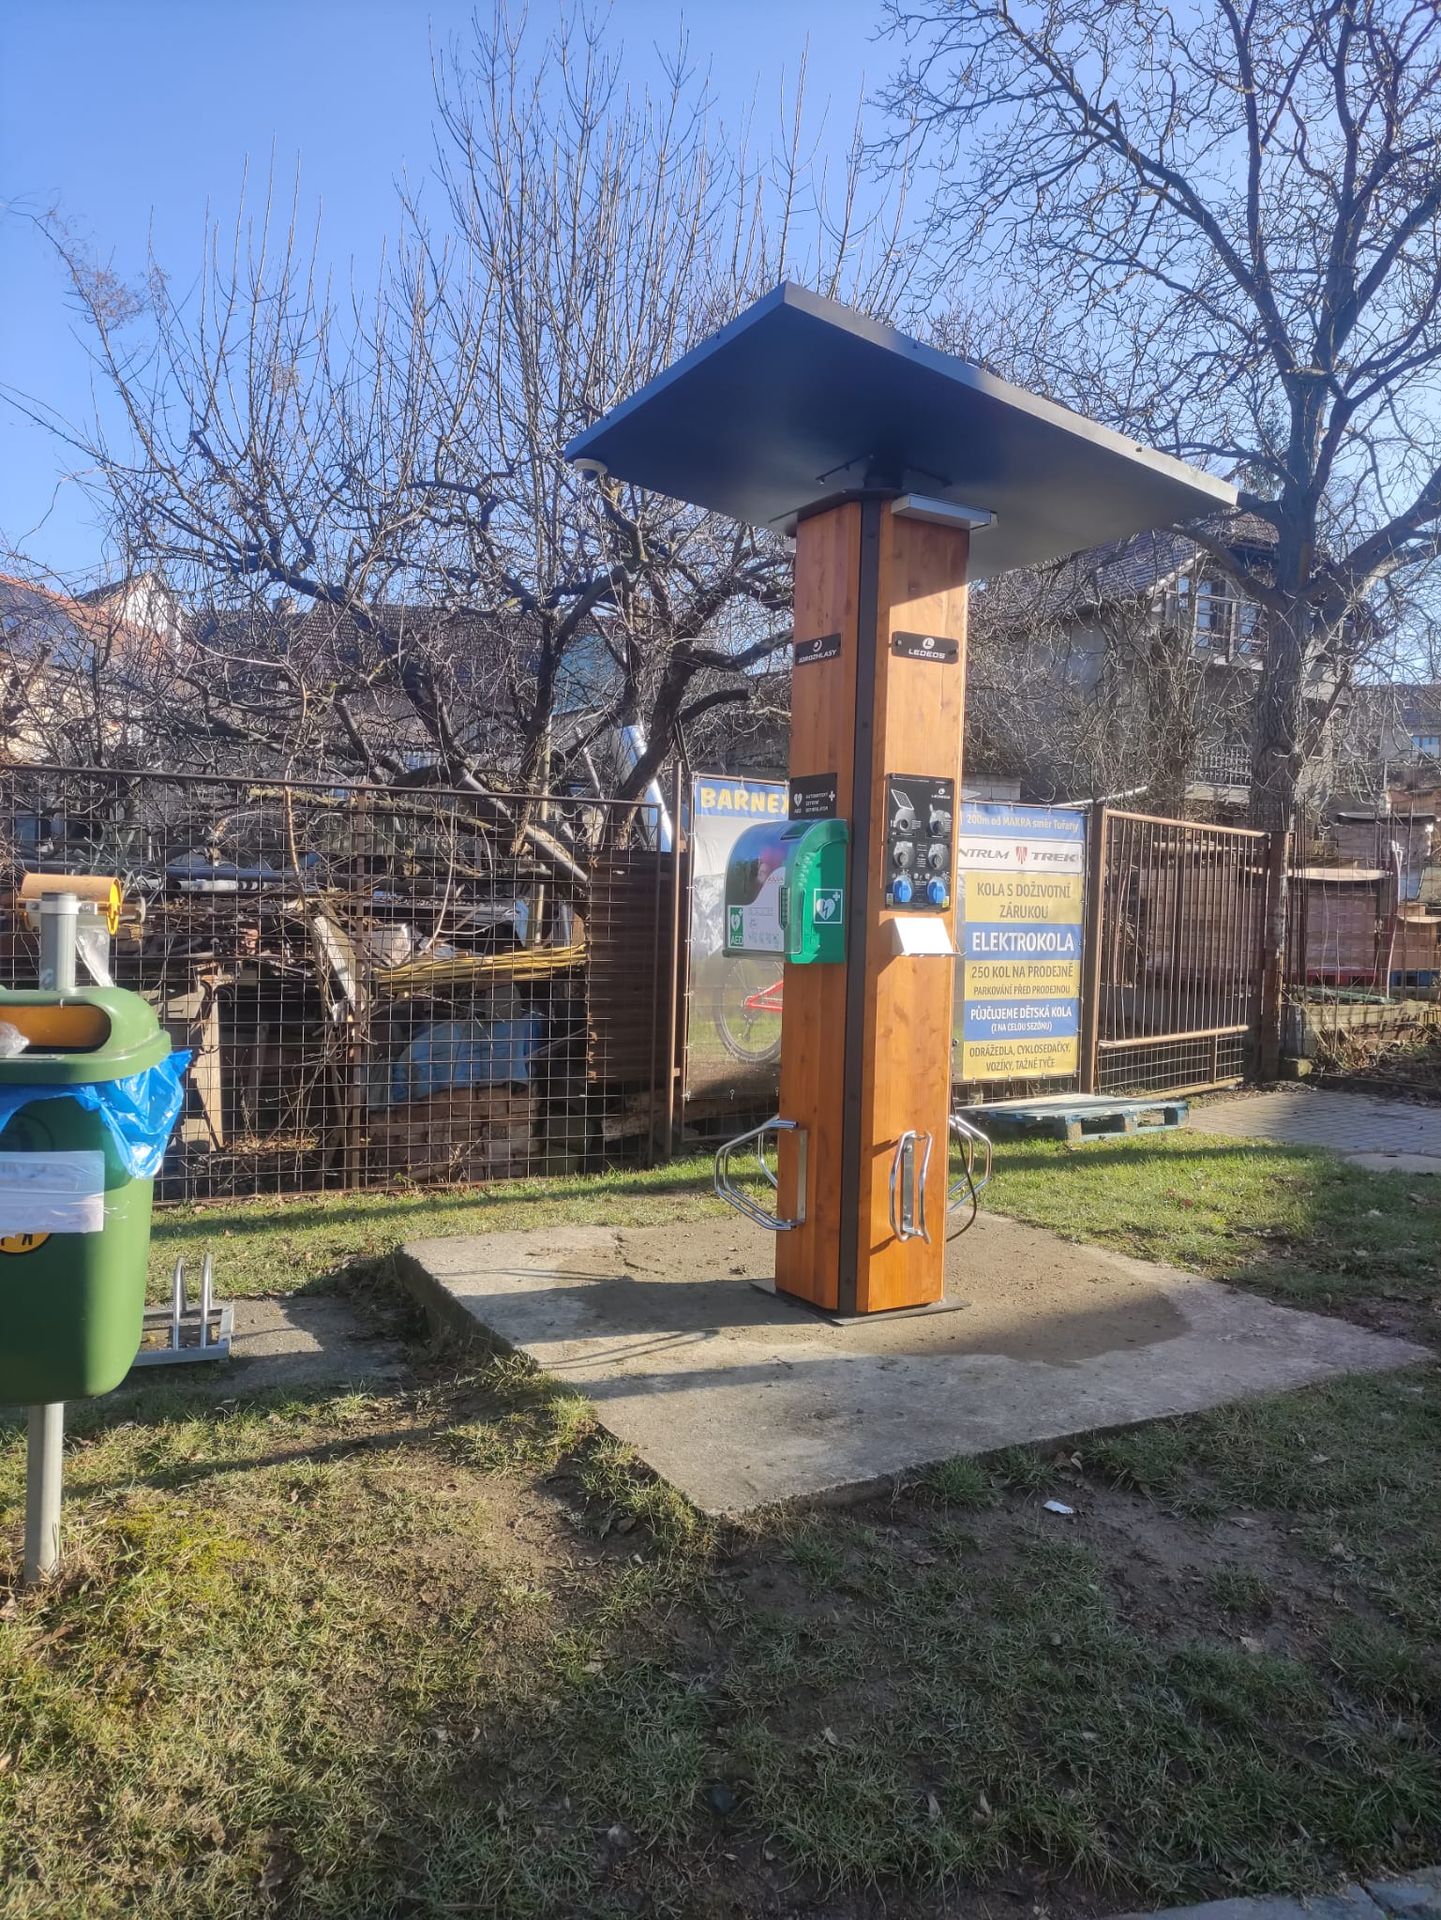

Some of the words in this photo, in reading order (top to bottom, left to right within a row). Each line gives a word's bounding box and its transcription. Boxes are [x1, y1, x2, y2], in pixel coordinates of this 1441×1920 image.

[967, 813, 990, 825] 200m
[991, 815, 1001, 826] od
[1002, 816, 1032, 828] MAKRA
[1031, 852, 1077, 862] TREK
[977, 882, 1005, 896] KOLA
[1006, 883, 1014, 897] S
[1016, 881, 1071, 898] DOŽIVOTNÍ
[999, 901, 1049, 919] ZÁRUKOU
[972, 932, 1075, 952] ELEKTROKOLA
[971, 966, 990, 978] 250
[992, 966, 1011, 978] KOL
[1012, 966, 1026, 978] NA
[973, 984, 1013, 996] PARKOVÁNÍ
[1013, 983, 1031, 995] PŘED
[1031, 984, 1071, 995] PRODEJNOU
[970, 1004, 1019, 1020] PŮJČUJEME
[1019, 1004, 1050, 1019] DĚTSKÁ
[1051, 1006, 1073, 1017] KOLA
